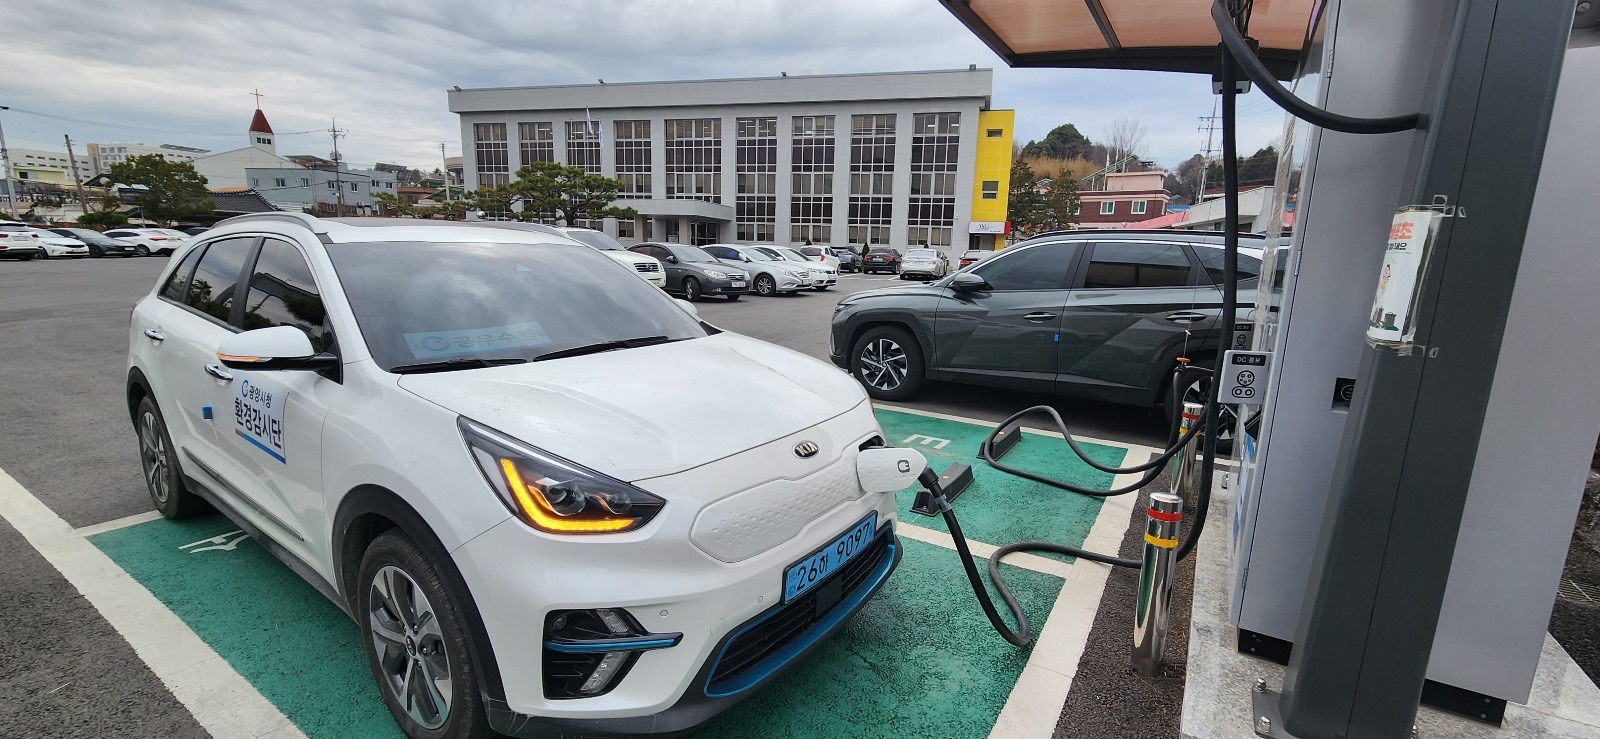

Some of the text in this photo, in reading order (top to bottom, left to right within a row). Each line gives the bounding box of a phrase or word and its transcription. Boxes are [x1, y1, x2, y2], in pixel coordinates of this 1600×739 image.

[453, 328, 543, 348] 공무수행
[249, 385, 273, 409] 광양시청
[235, 397, 282, 450] 환경감시단
[836, 521, 871, 564] 9097
